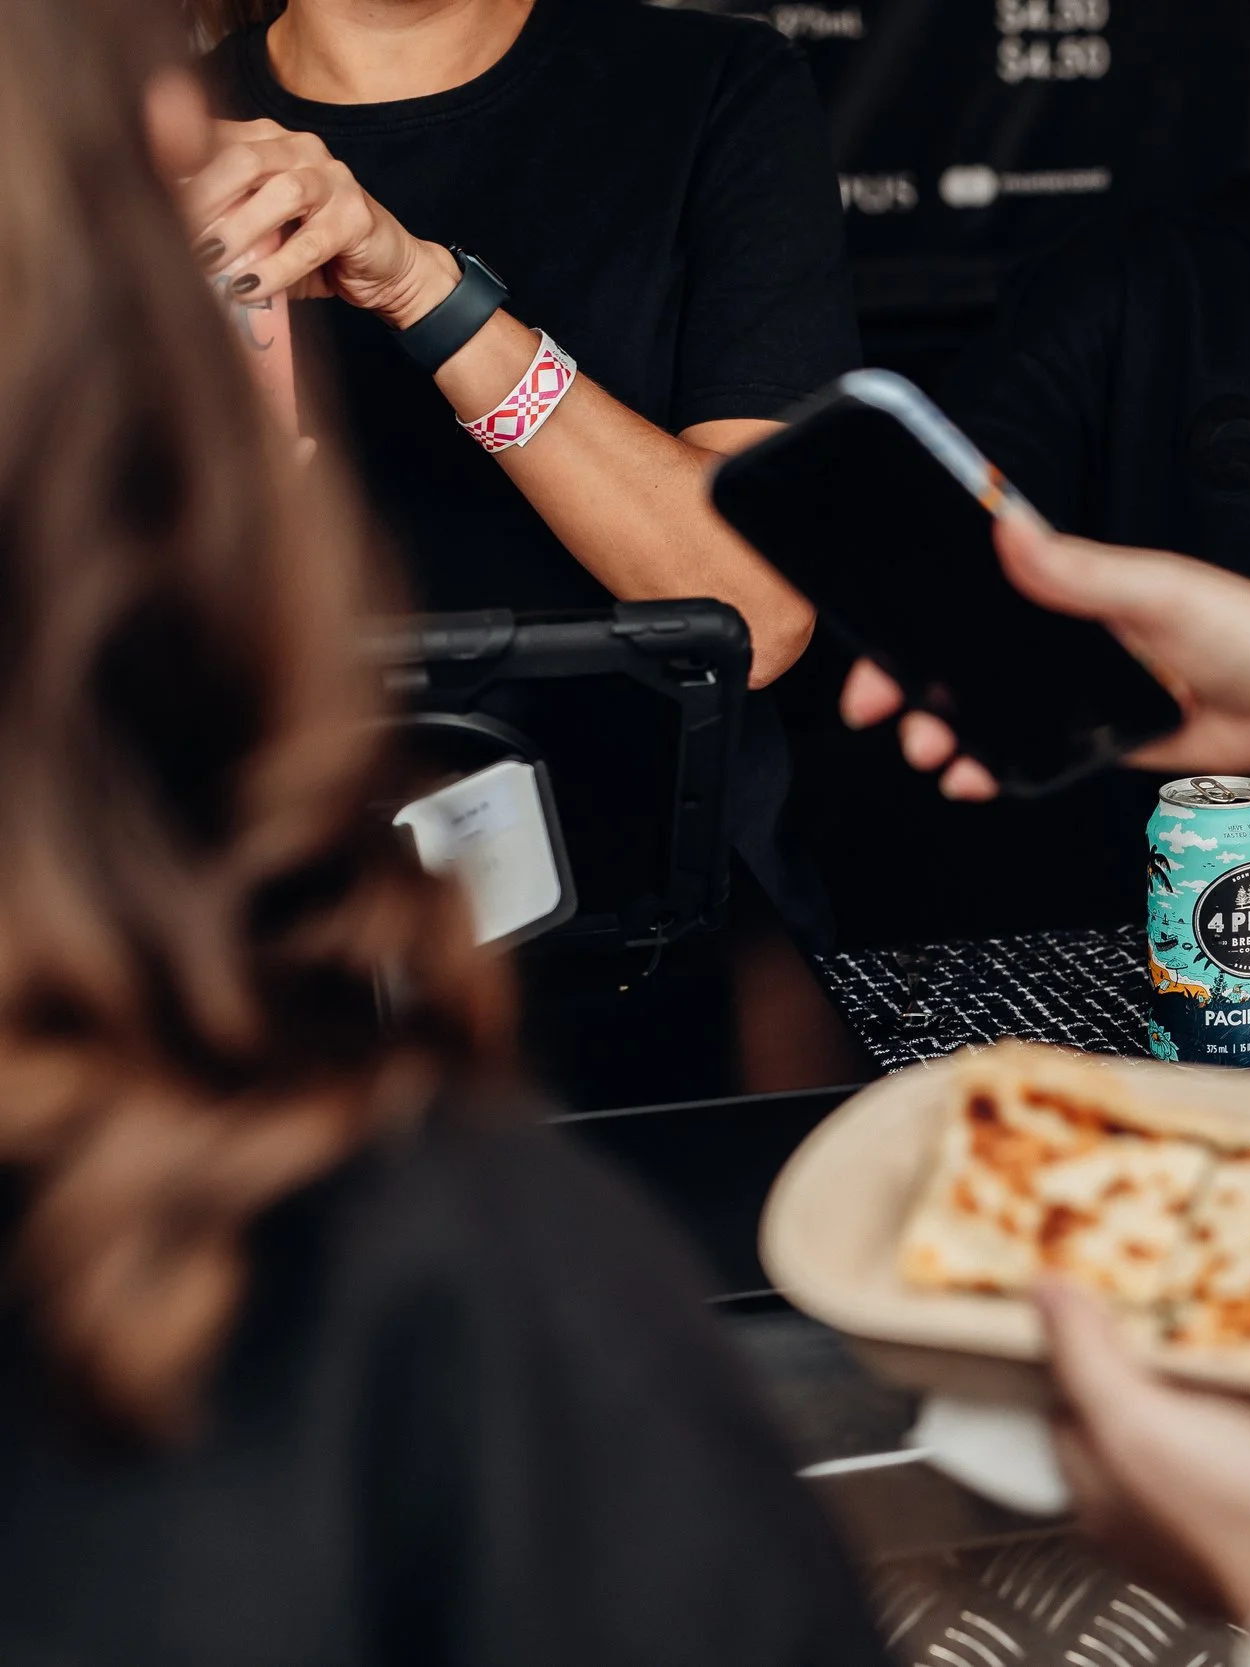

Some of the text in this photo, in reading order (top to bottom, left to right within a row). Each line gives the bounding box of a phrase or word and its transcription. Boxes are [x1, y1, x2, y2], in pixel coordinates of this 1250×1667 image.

[1223, 831, 1247, 839] TASTED
[1207, 912, 1225, 933] 4
[1206, 1044, 1217, 1054] 375
[1218, 1044, 1229, 1054] mL
[1240, 1043, 1246, 1052] 15
